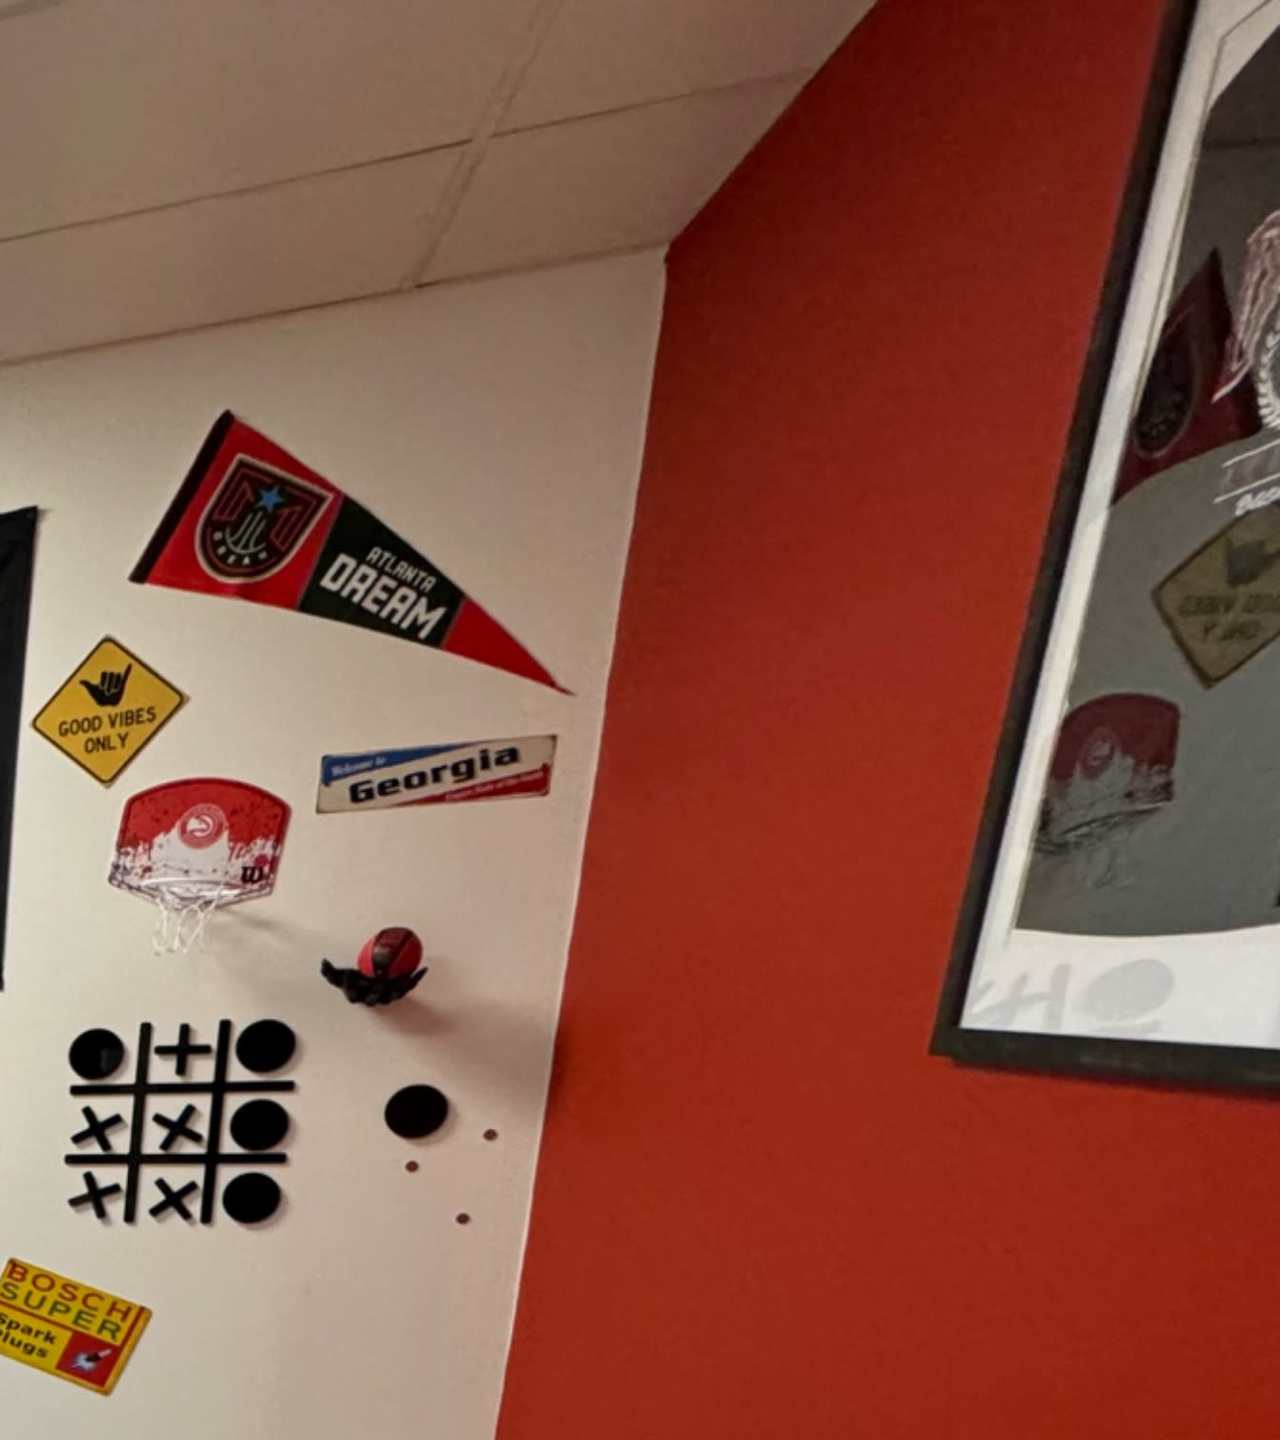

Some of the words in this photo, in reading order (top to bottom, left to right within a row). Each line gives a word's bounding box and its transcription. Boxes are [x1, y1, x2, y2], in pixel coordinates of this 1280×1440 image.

[320, 553, 447, 640] DREAM
[365, 546, 437, 593] ATLANTA
[58, 715, 102, 737] GOOD
[107, 706, 157, 729] VIBES
[83, 731, 129, 753] ONLY
[349, 746, 520, 803] Georgia
[0, 1281, 122, 1342] SUPER
[6, 1262, 133, 1323] BOSCH
